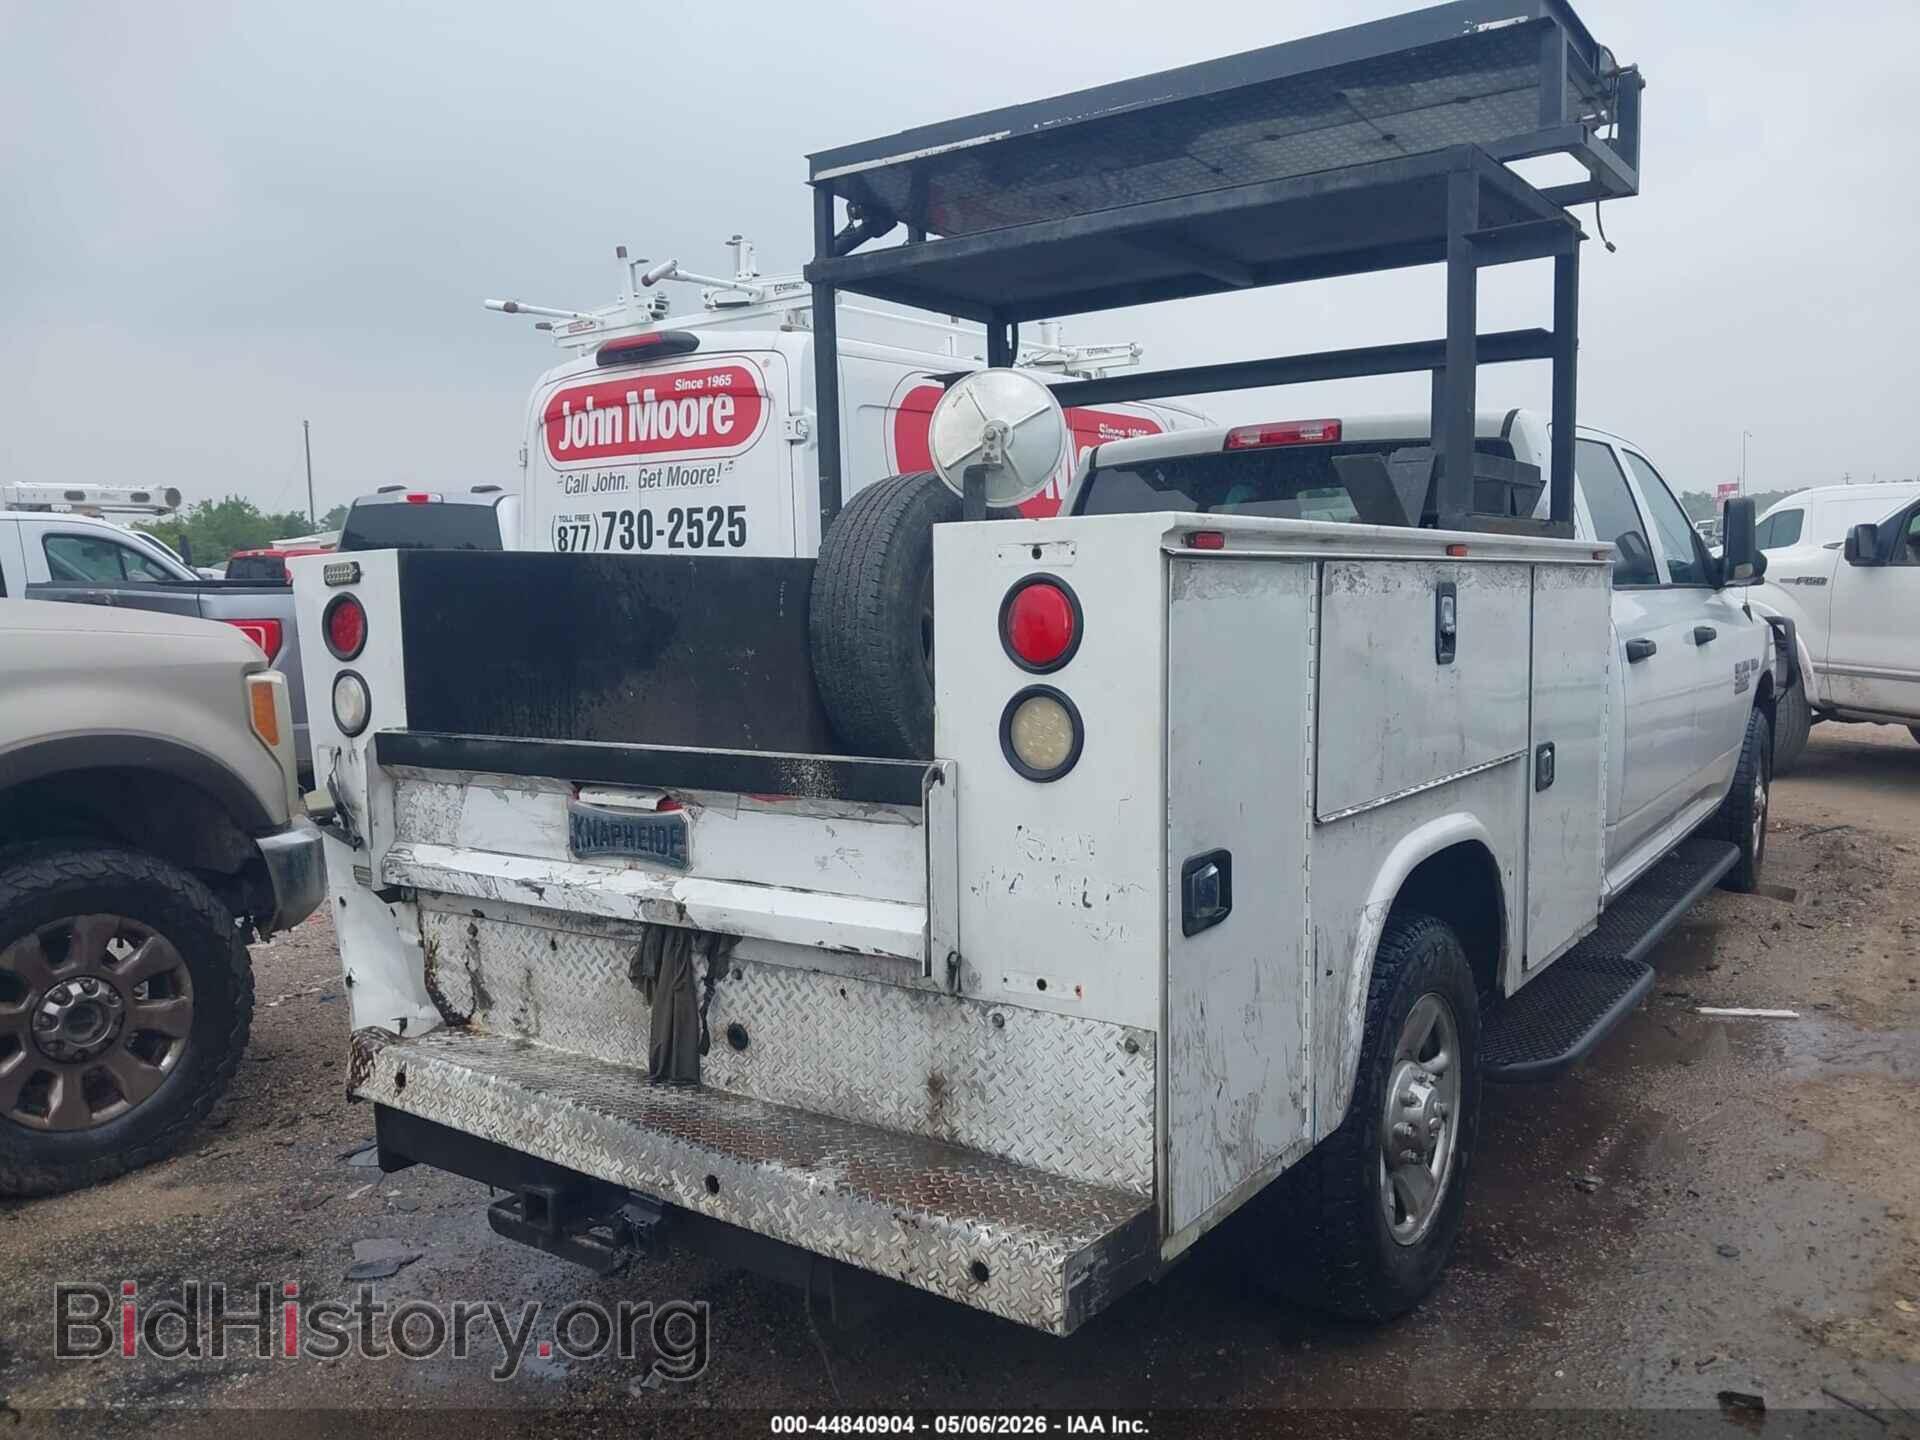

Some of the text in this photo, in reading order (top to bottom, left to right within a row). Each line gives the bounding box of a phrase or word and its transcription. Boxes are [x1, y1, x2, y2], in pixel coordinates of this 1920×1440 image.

[675, 374, 732, 392] Since 1965
[558, 388, 735, 450] John Moore
[565, 463, 722, 494] Call John. Get Moore!
[558, 514, 591, 523] TOLL FREE
[602, 505, 747, 550] 730-2525
[572, 813, 682, 858] KNAPHEIDE
